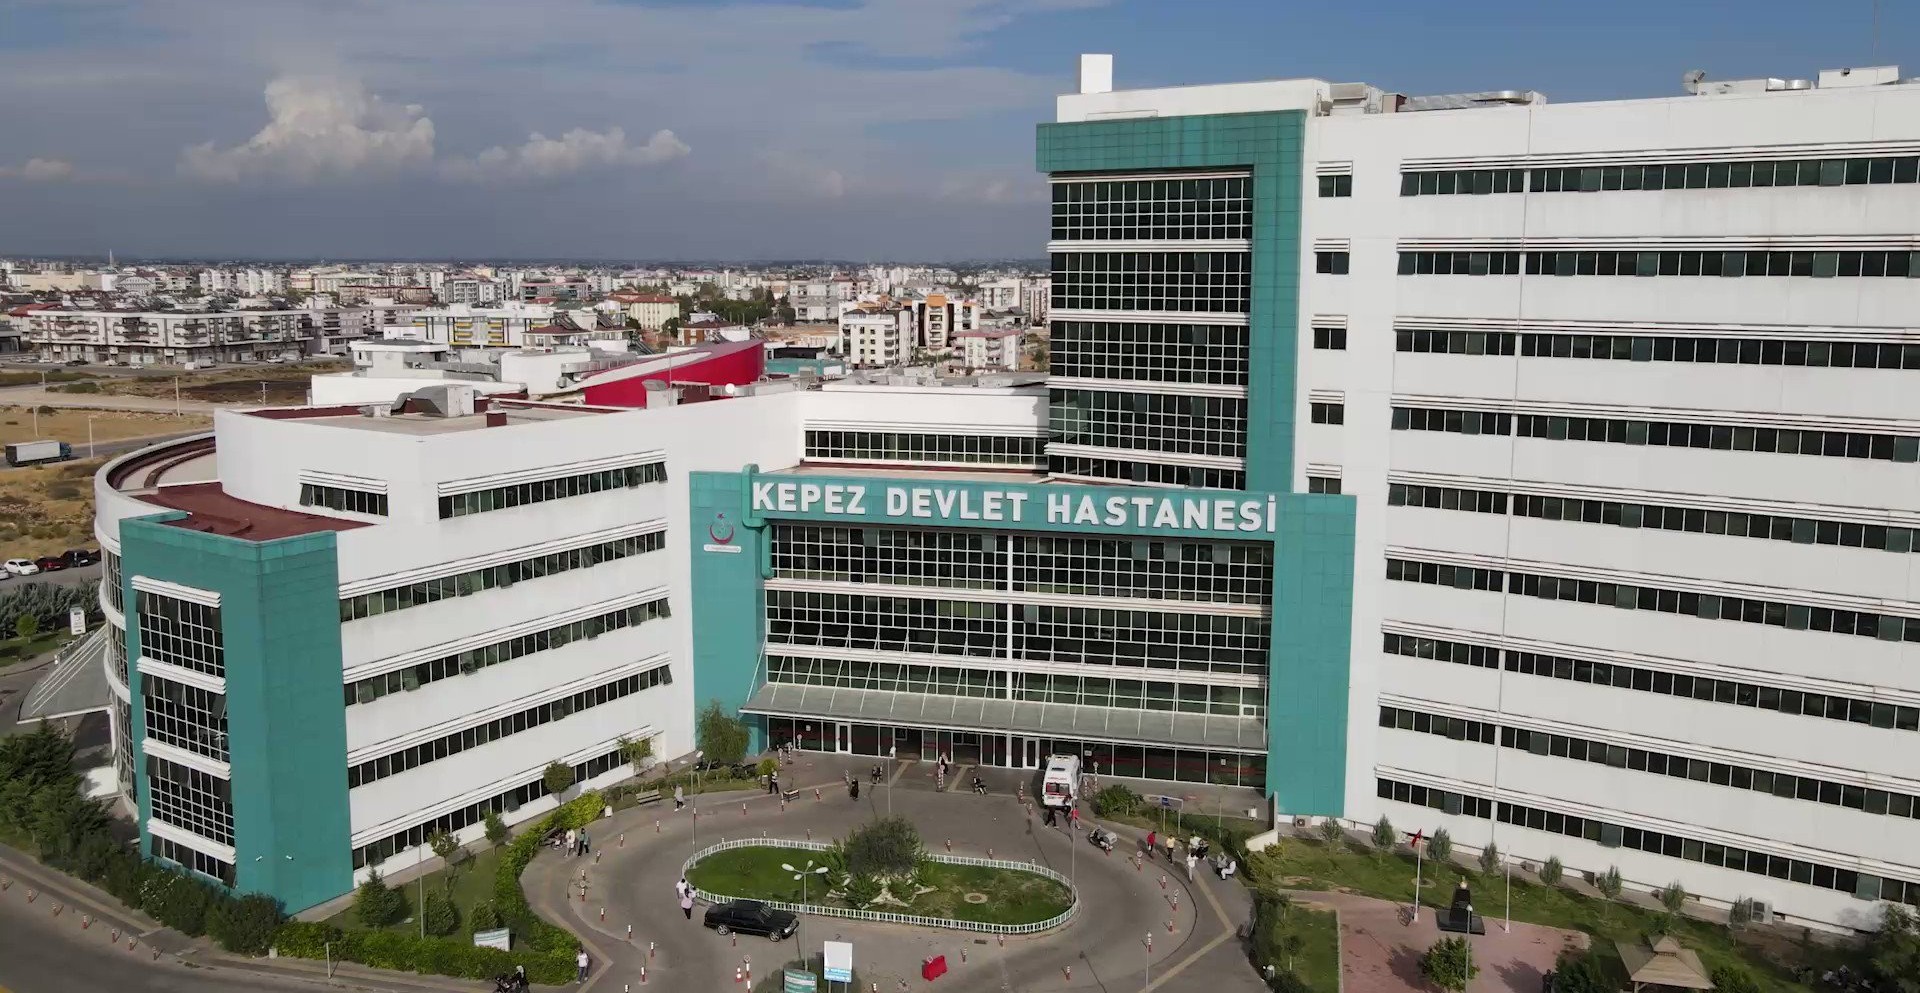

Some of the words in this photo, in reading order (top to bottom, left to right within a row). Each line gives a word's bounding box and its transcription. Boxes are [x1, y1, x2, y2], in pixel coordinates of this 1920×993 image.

[753, 482, 866, 515] KEPEZ
[887, 487, 1028, 522] DEVLET
[1047, 493, 1277, 533] HASTANESİ
